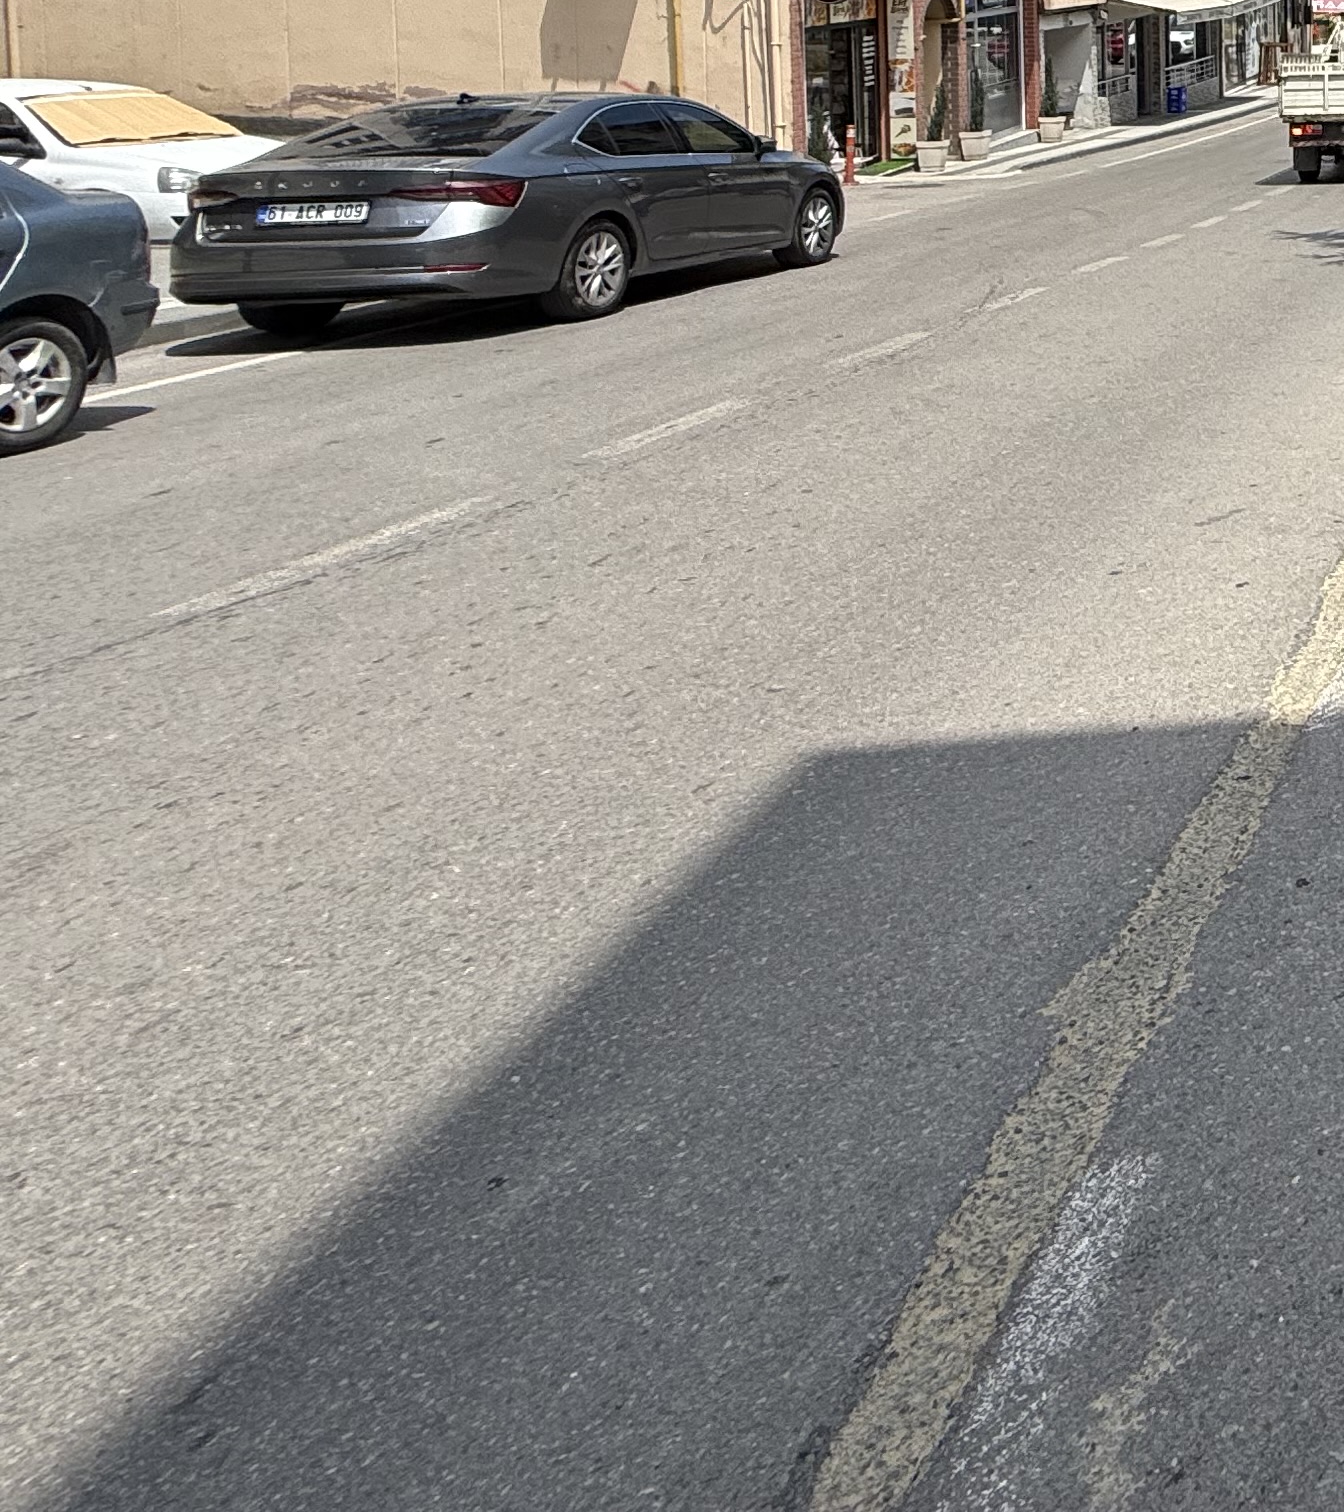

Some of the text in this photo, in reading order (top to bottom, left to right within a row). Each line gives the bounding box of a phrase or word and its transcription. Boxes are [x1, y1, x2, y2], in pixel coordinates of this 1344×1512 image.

[267, 203, 364, 221] 61 ACR 009
